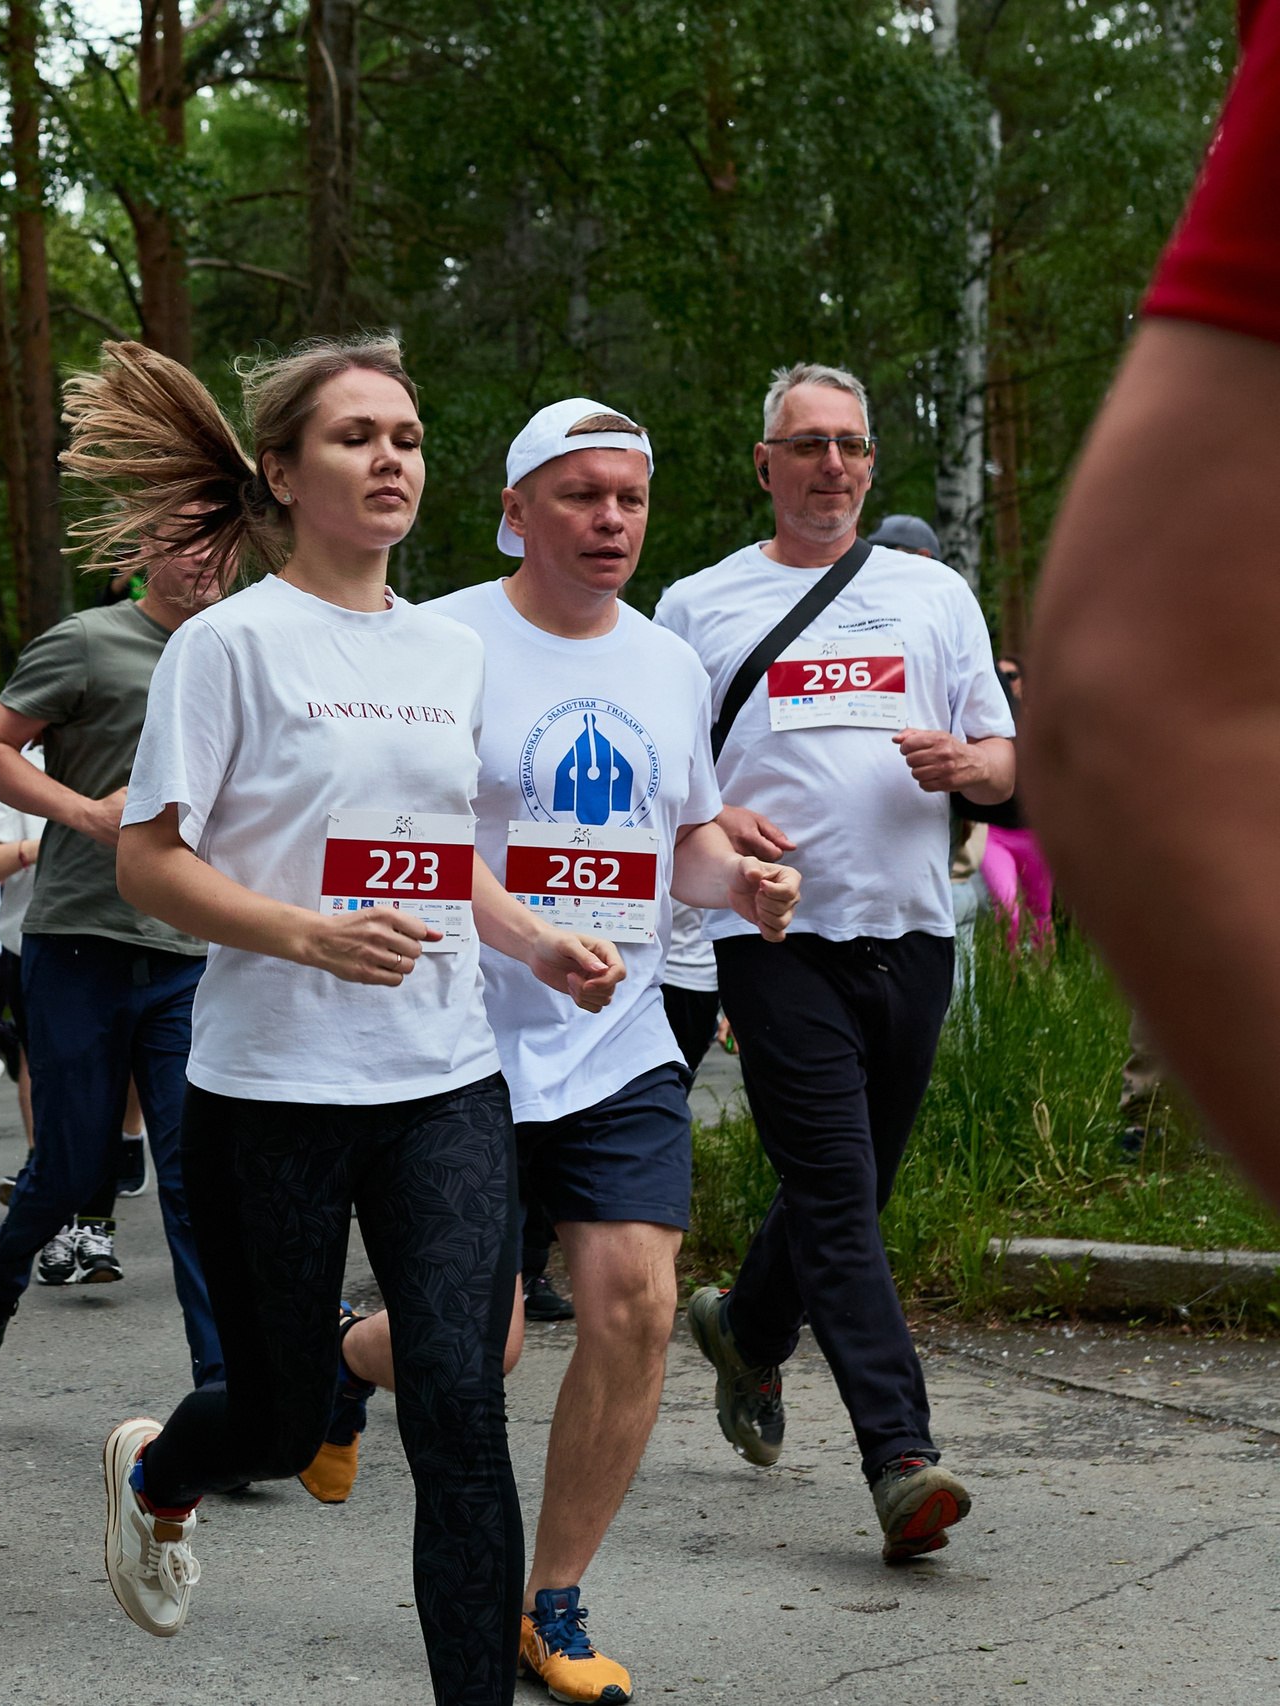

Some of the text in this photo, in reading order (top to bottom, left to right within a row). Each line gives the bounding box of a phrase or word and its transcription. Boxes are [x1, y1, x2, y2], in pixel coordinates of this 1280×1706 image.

[803, 661, 871, 691] 296
[306, 702, 456, 725] DANCING QUEEN
[523, 700, 660, 799] СВЕРДЛОВСКАЯ ОБЛАСТНАЯ ГИЛЬДИЯ АДВОКАТОВ
[365, 850, 439, 891] 223
[546, 855, 620, 891] 262
